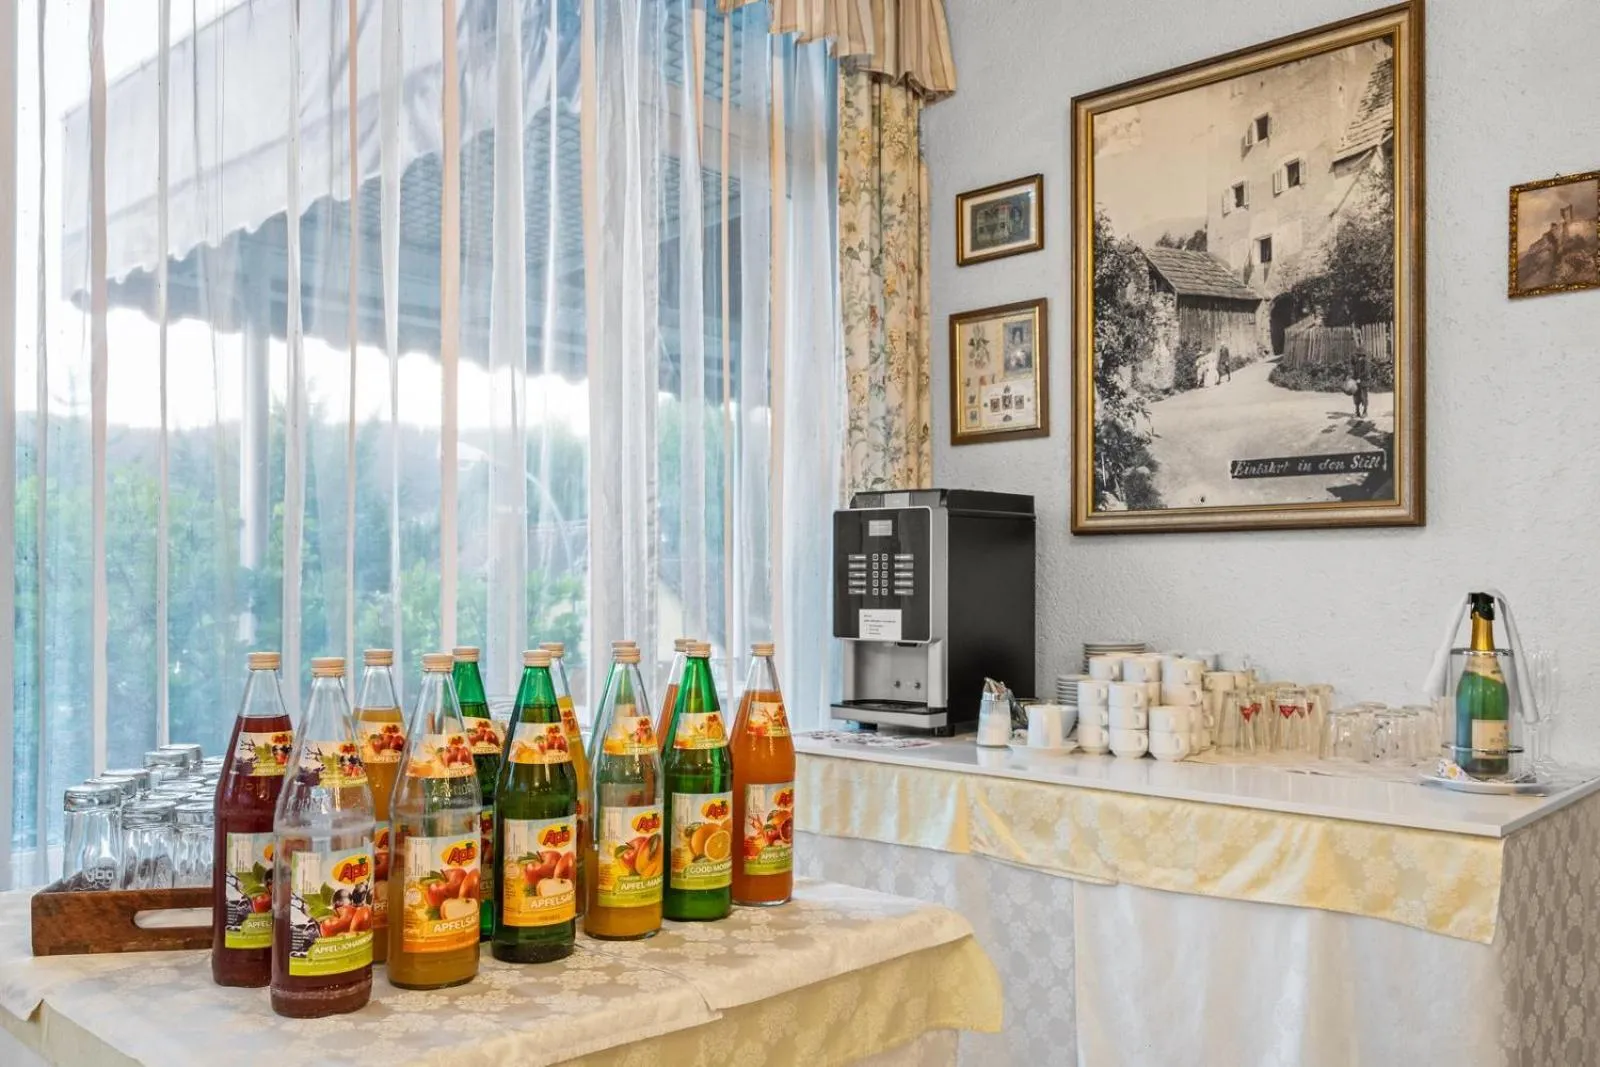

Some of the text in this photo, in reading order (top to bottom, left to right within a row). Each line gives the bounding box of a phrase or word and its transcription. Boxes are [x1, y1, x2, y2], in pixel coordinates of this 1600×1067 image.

[1297, 460, 1312, 473] in
[1318, 458, 1345, 472] den
[690, 865, 712, 875] GOOD
